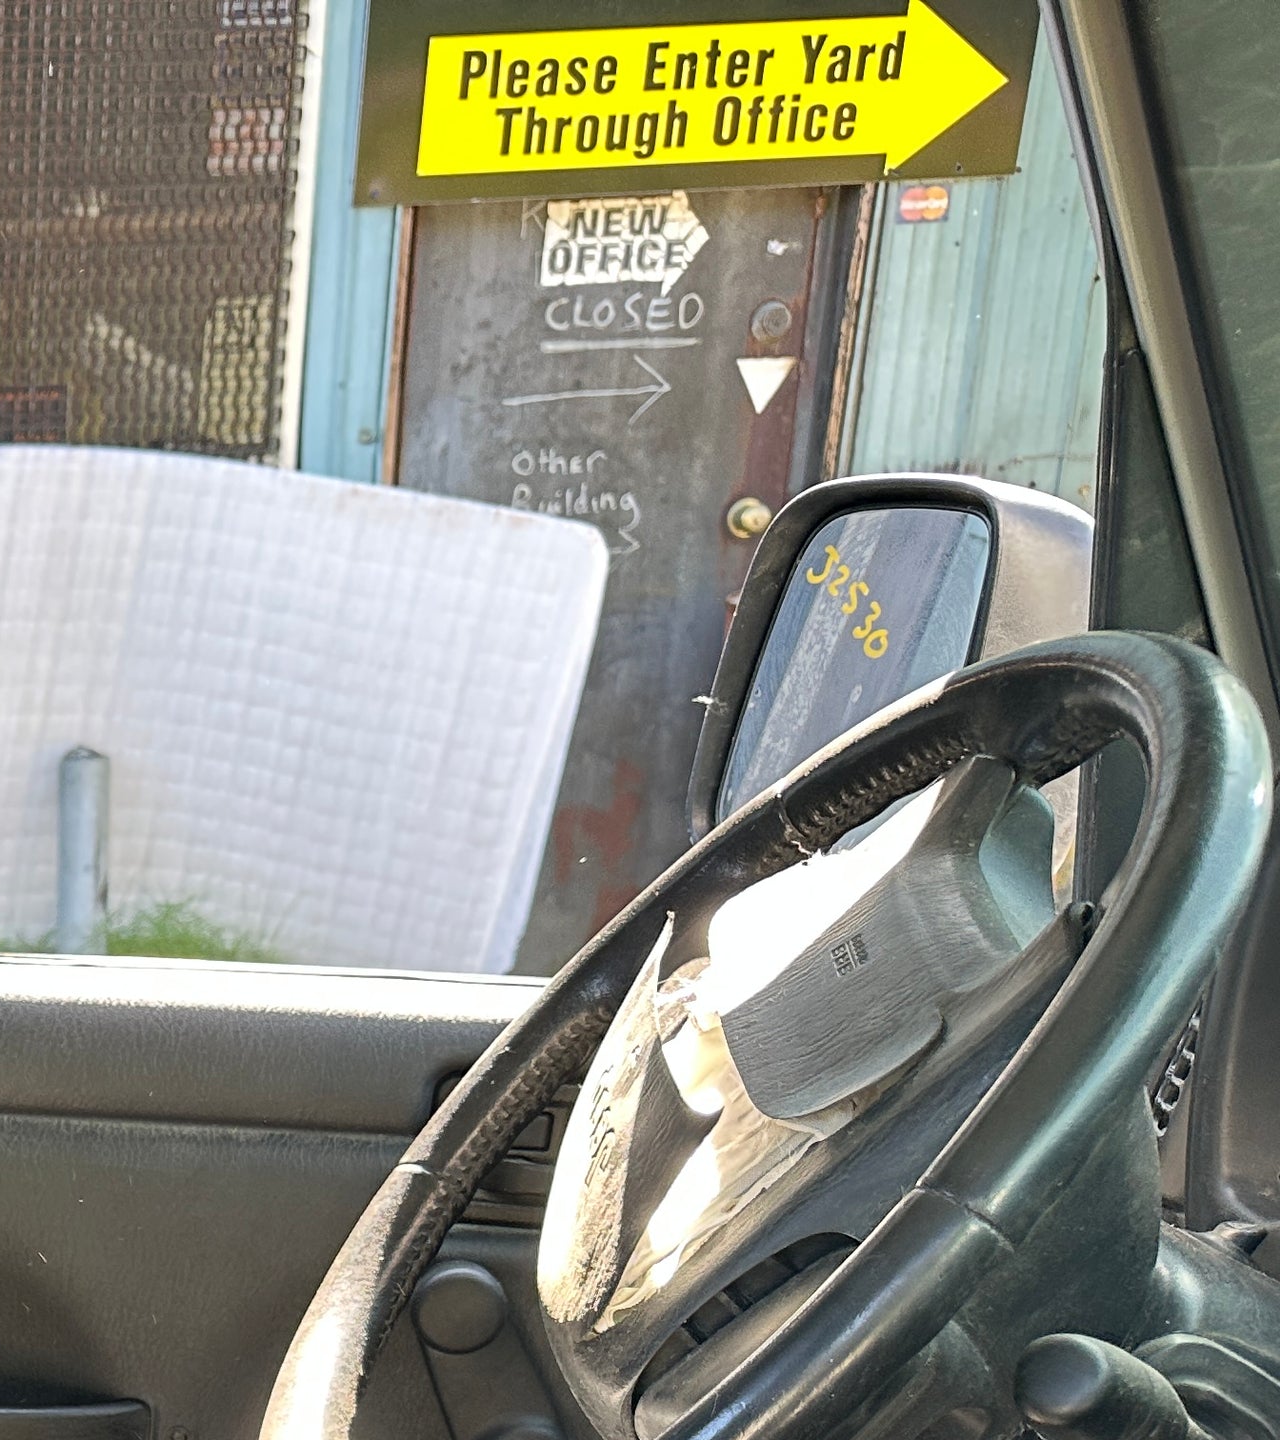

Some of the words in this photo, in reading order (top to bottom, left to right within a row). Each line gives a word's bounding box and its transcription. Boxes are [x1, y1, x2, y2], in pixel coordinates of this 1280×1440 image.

[459, 49, 618, 100] Please
[643, 39, 775, 91] Enter
[801, 31, 906, 84] Yard
[495, 99, 688, 159] Through
[713, 94, 857, 146] Office
[571, 205, 668, 240] NEW
[548, 238, 687, 275] OFFICE
[545, 292, 704, 332] CLOSED
